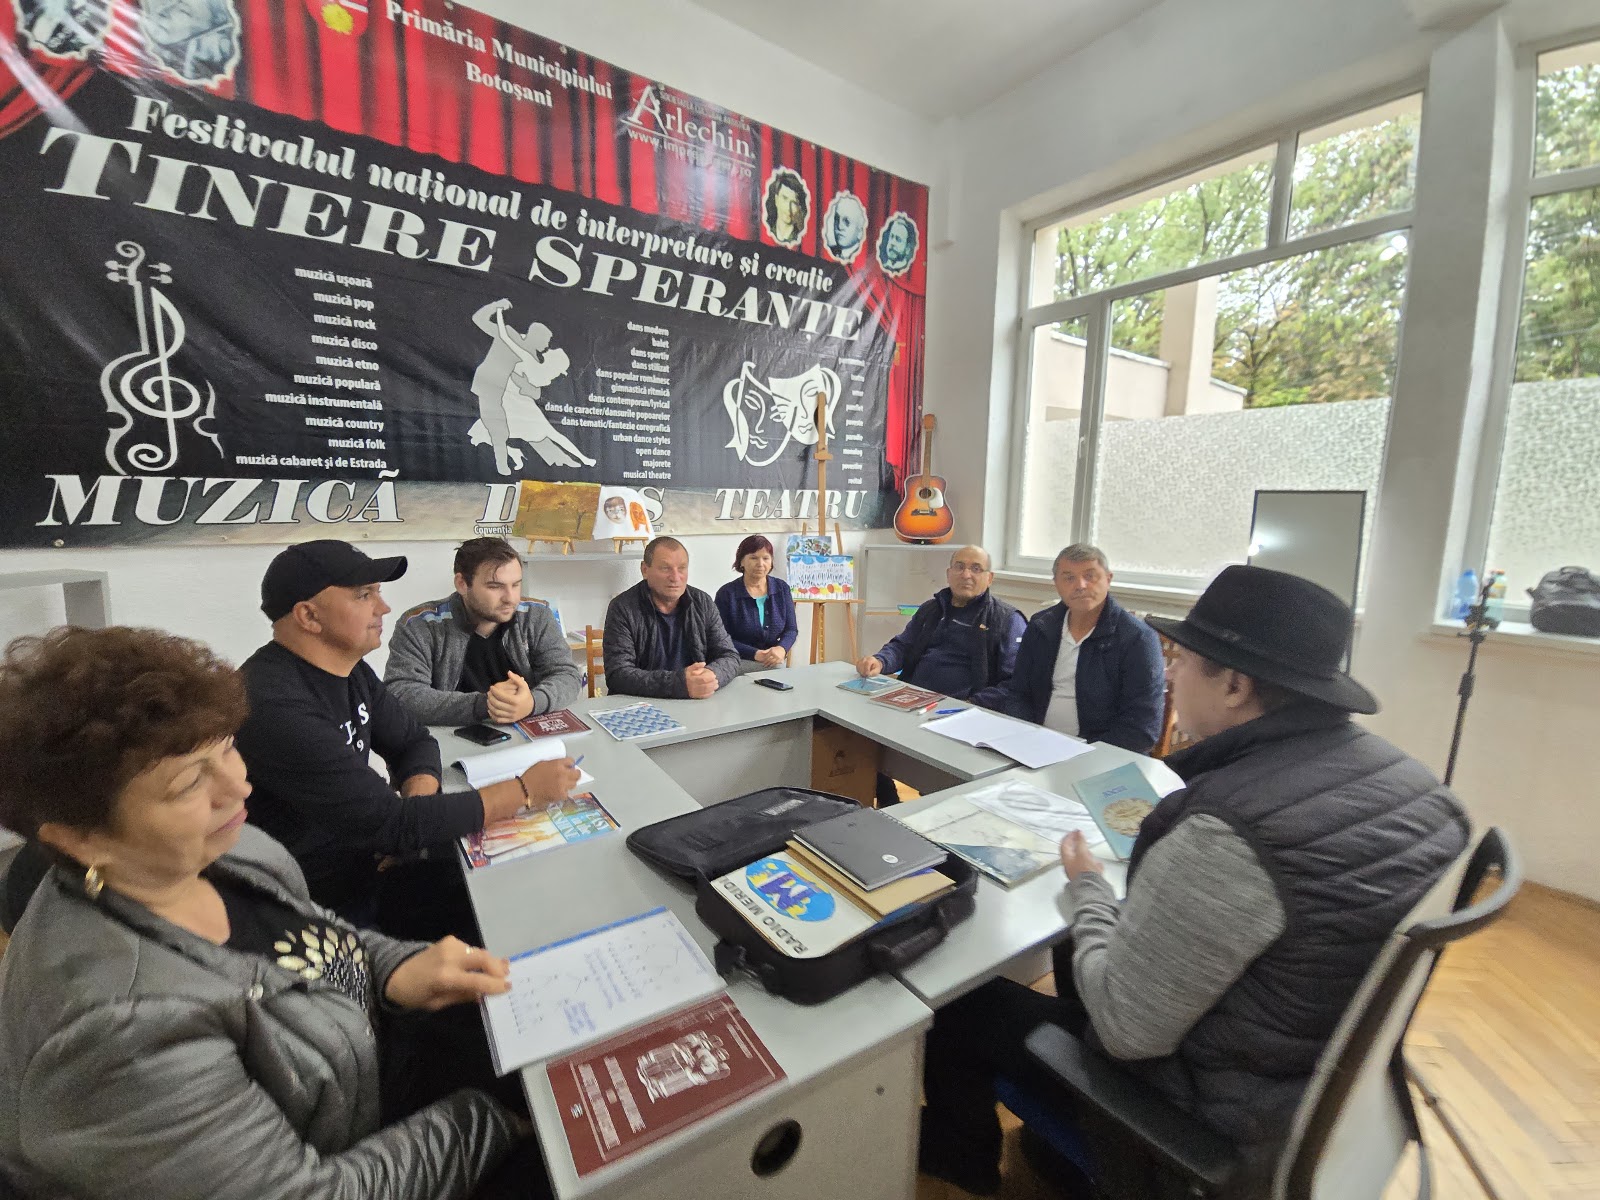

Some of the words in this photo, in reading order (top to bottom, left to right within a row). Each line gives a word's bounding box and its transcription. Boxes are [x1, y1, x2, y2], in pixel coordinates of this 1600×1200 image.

[386, 0, 486, 53] Primăria
[492, 38, 612, 99] Municipiului
[127, 95, 356, 181] Festivalul
[368, 163, 521, 220] național
[530, 198, 568, 231] de
[577, 208, 734, 270] interpretare
[39, 126, 497, 273] TINERE
[528, 236, 863, 341] SPERANȚE
[294, 267, 335, 282] muzică
[313, 292, 353, 306] muzică
[354, 298, 375, 311] pop
[313, 313, 352, 327] muzică
[353, 318, 376, 330] rock
[311, 334, 350, 348] muzică
[351, 337, 378, 351] disco
[315, 355, 353, 368] muzică
[355, 359, 379, 371] etno
[631, 360, 647, 371] dans
[293, 374, 333, 386] muzică
[335, 377, 381, 391] populară
[595, 368, 612, 378] dans
[613, 371, 639, 382] popular
[265, 392, 306, 405] muzică
[308, 394, 383, 411] instrumentală
[588, 393, 605, 404] dans
[545, 402, 563, 413] dans
[564, 403, 573, 413] de
[305, 416, 344, 428] muzică
[345, 418, 385, 432] country
[561, 416, 579, 427] dans
[328, 438, 364, 449] muzică
[365, 438, 386, 450] folk
[613, 433, 632, 443] urban
[633, 433, 652, 444] dance
[652, 435, 671, 445] styles
[635, 447, 652, 457] open
[652, 446, 671, 457] dance
[235, 454, 278, 466] muzică
[279, 455, 322, 467] cabaret
[334, 456, 349, 468] de
[350, 457, 387, 469] Estrada
[642, 459, 671, 469] majorete
[623, 470, 648, 479] musical
[648, 470, 672, 480] theatre
[763, 915, 809, 954] RADIO
